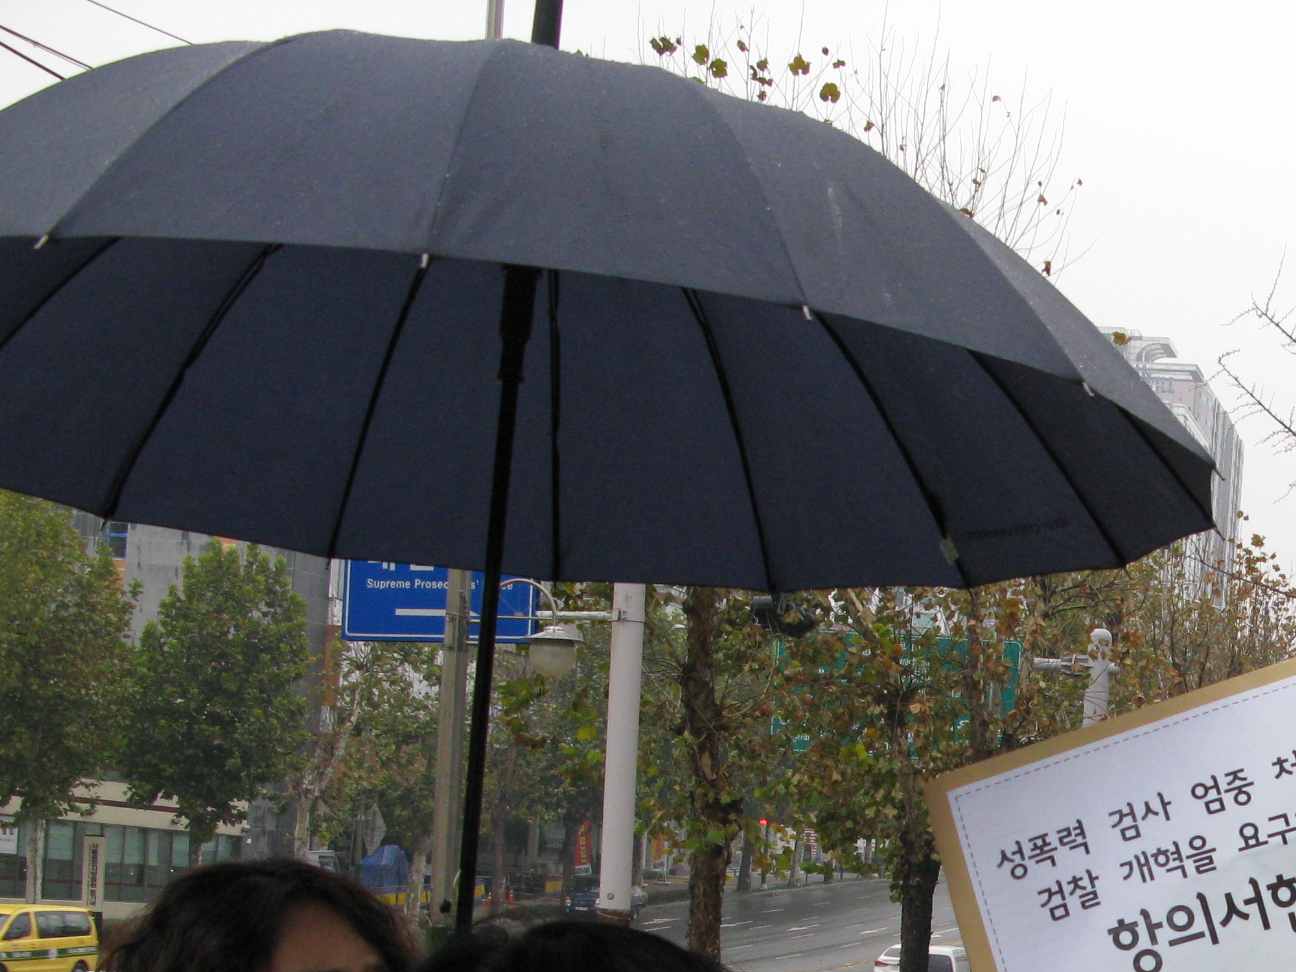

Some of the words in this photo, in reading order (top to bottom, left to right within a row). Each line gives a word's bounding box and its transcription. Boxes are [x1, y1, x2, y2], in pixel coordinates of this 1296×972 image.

[366, 578, 411, 591] Supreme
[414, 578, 479, 590] Prosecs'
[997, 819, 1091, 880] 성폭력
[1108, 792, 1172, 842] 검사
[1191, 768, 1255, 815] 엄중
[1037, 869, 1101, 922] 검찰
[1119, 835, 1217, 884] 개혁을
